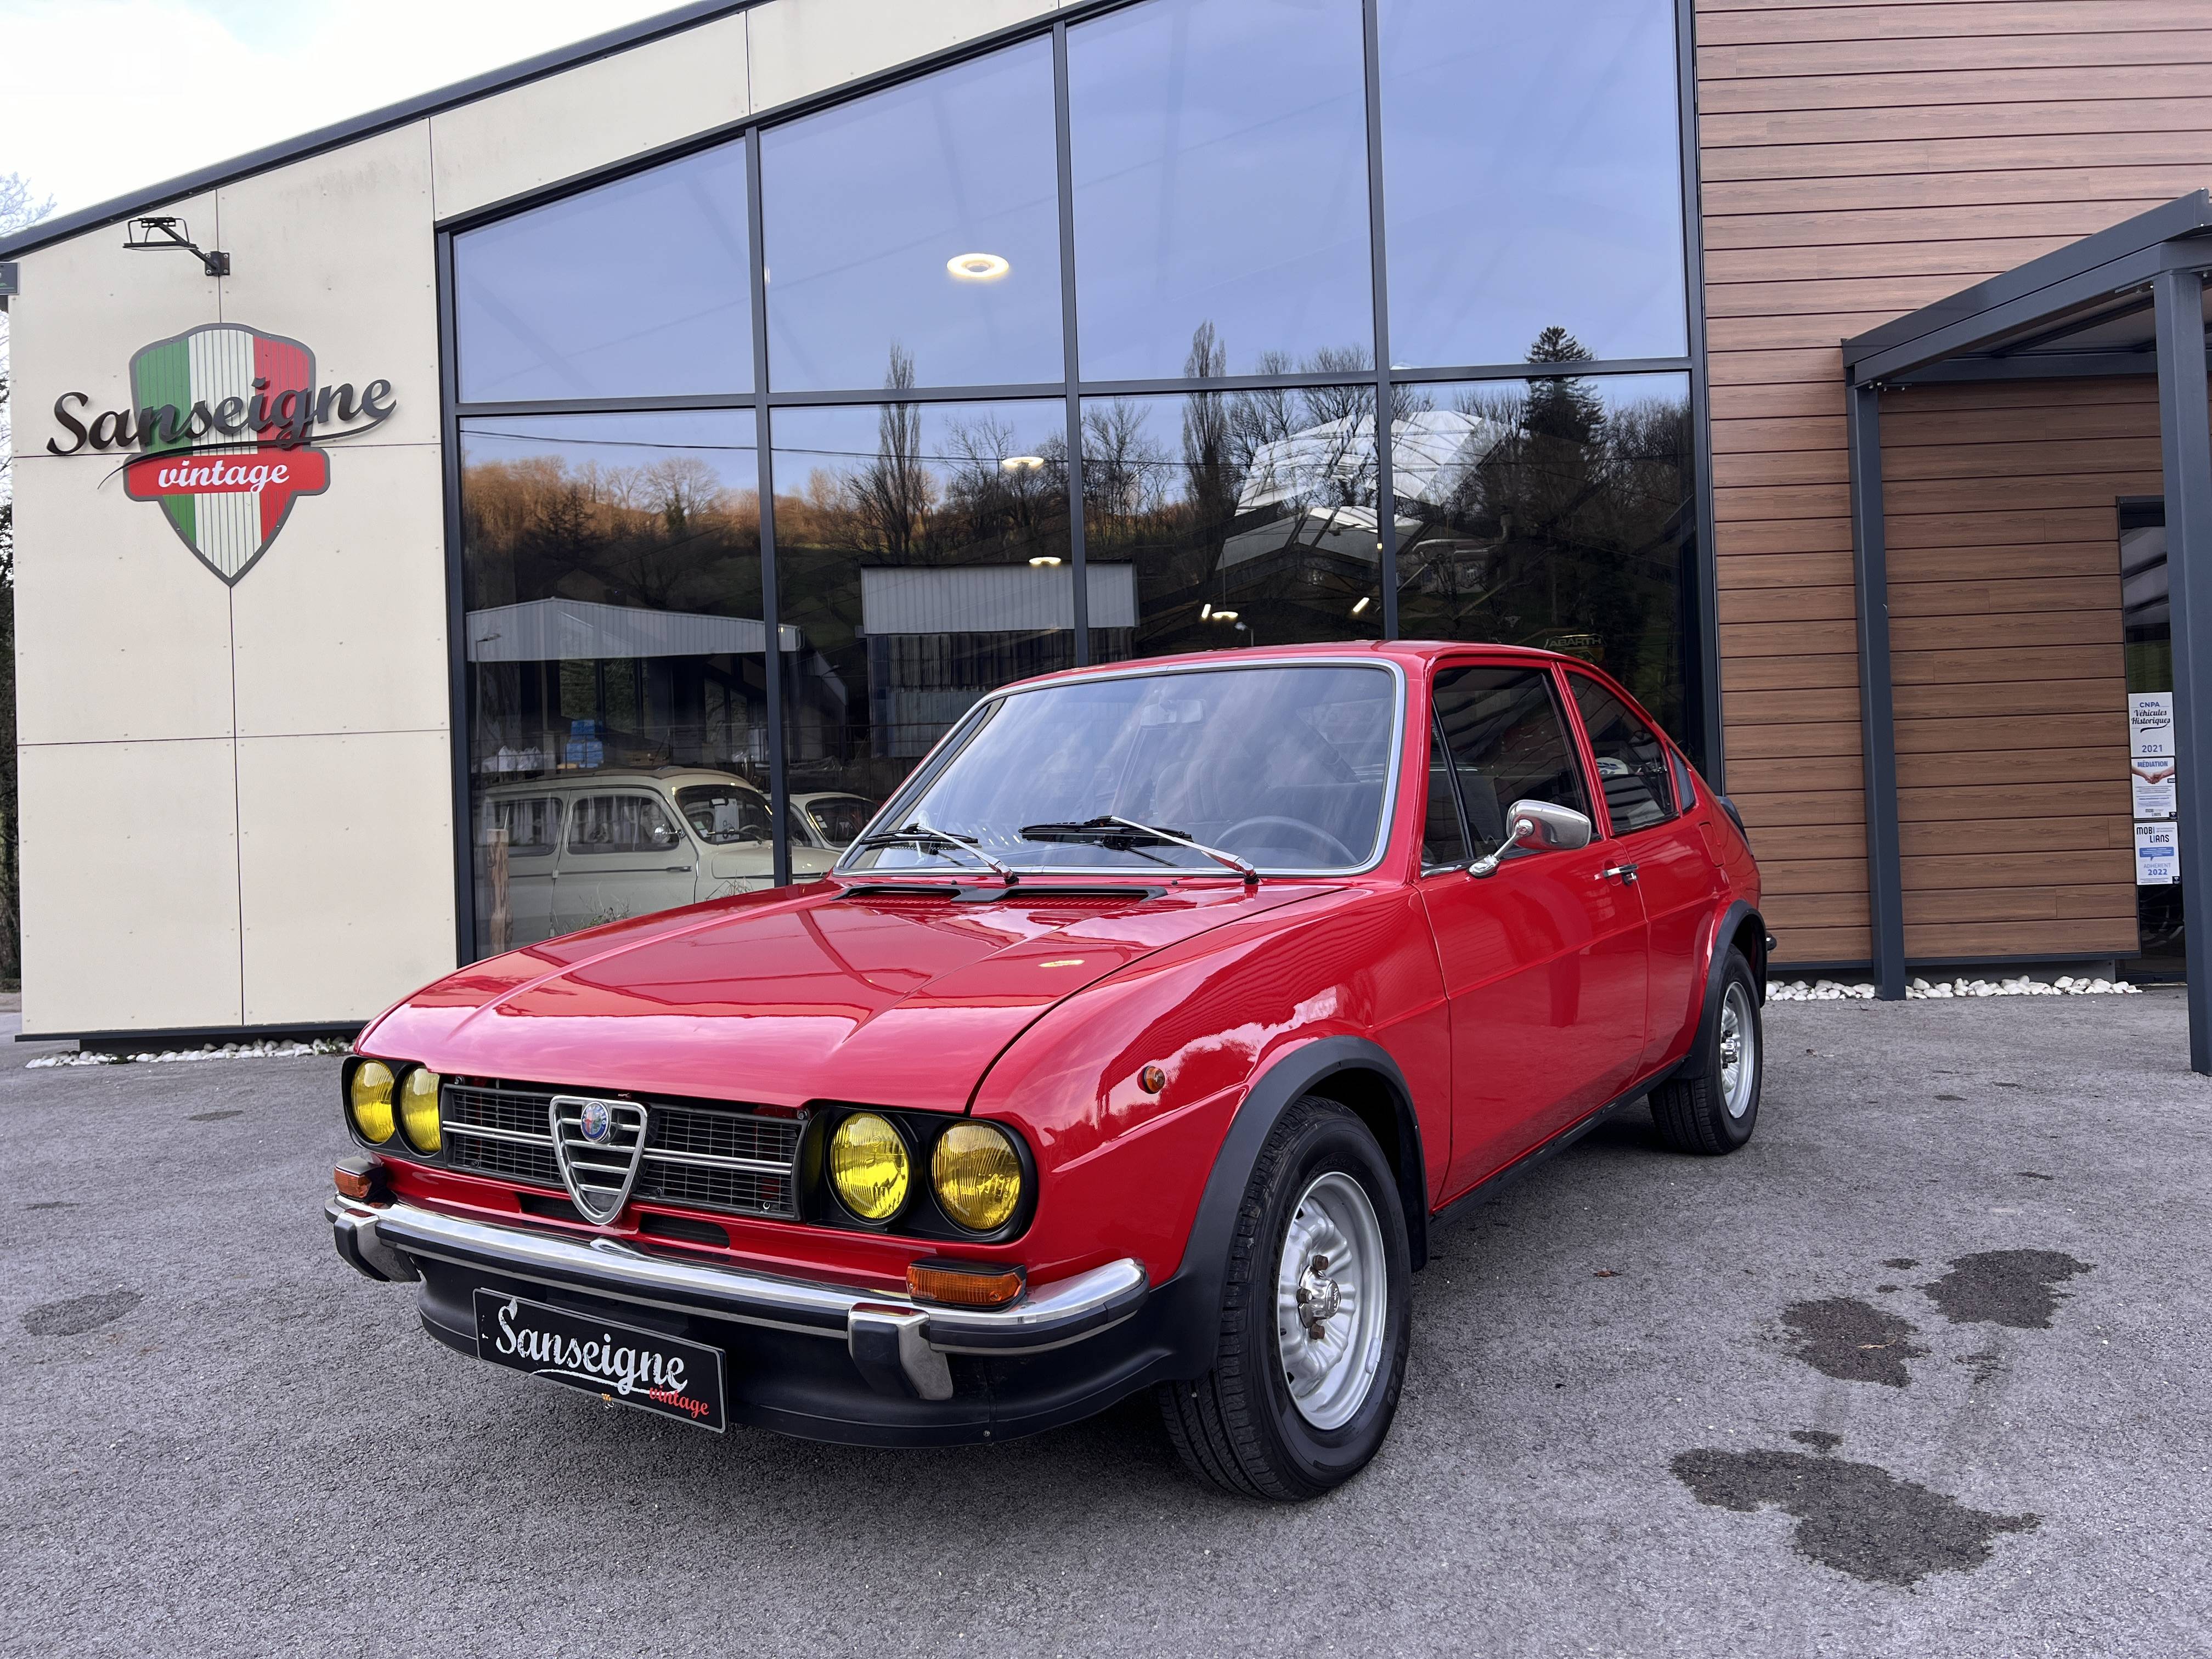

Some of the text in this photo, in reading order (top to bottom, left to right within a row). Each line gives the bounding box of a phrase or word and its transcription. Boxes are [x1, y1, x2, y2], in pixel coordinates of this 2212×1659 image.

[47, 377, 397, 455] Sanseigne
[157, 458, 290, 494] vintage
[1549, 637, 1601, 647] ABARTH
[2131, 717, 2170, 726] Historiques
[2142, 744, 2163, 753] 2021
[495, 1297, 688, 1395] Sanseigne
[648, 1384, 710, 1419] vintage
